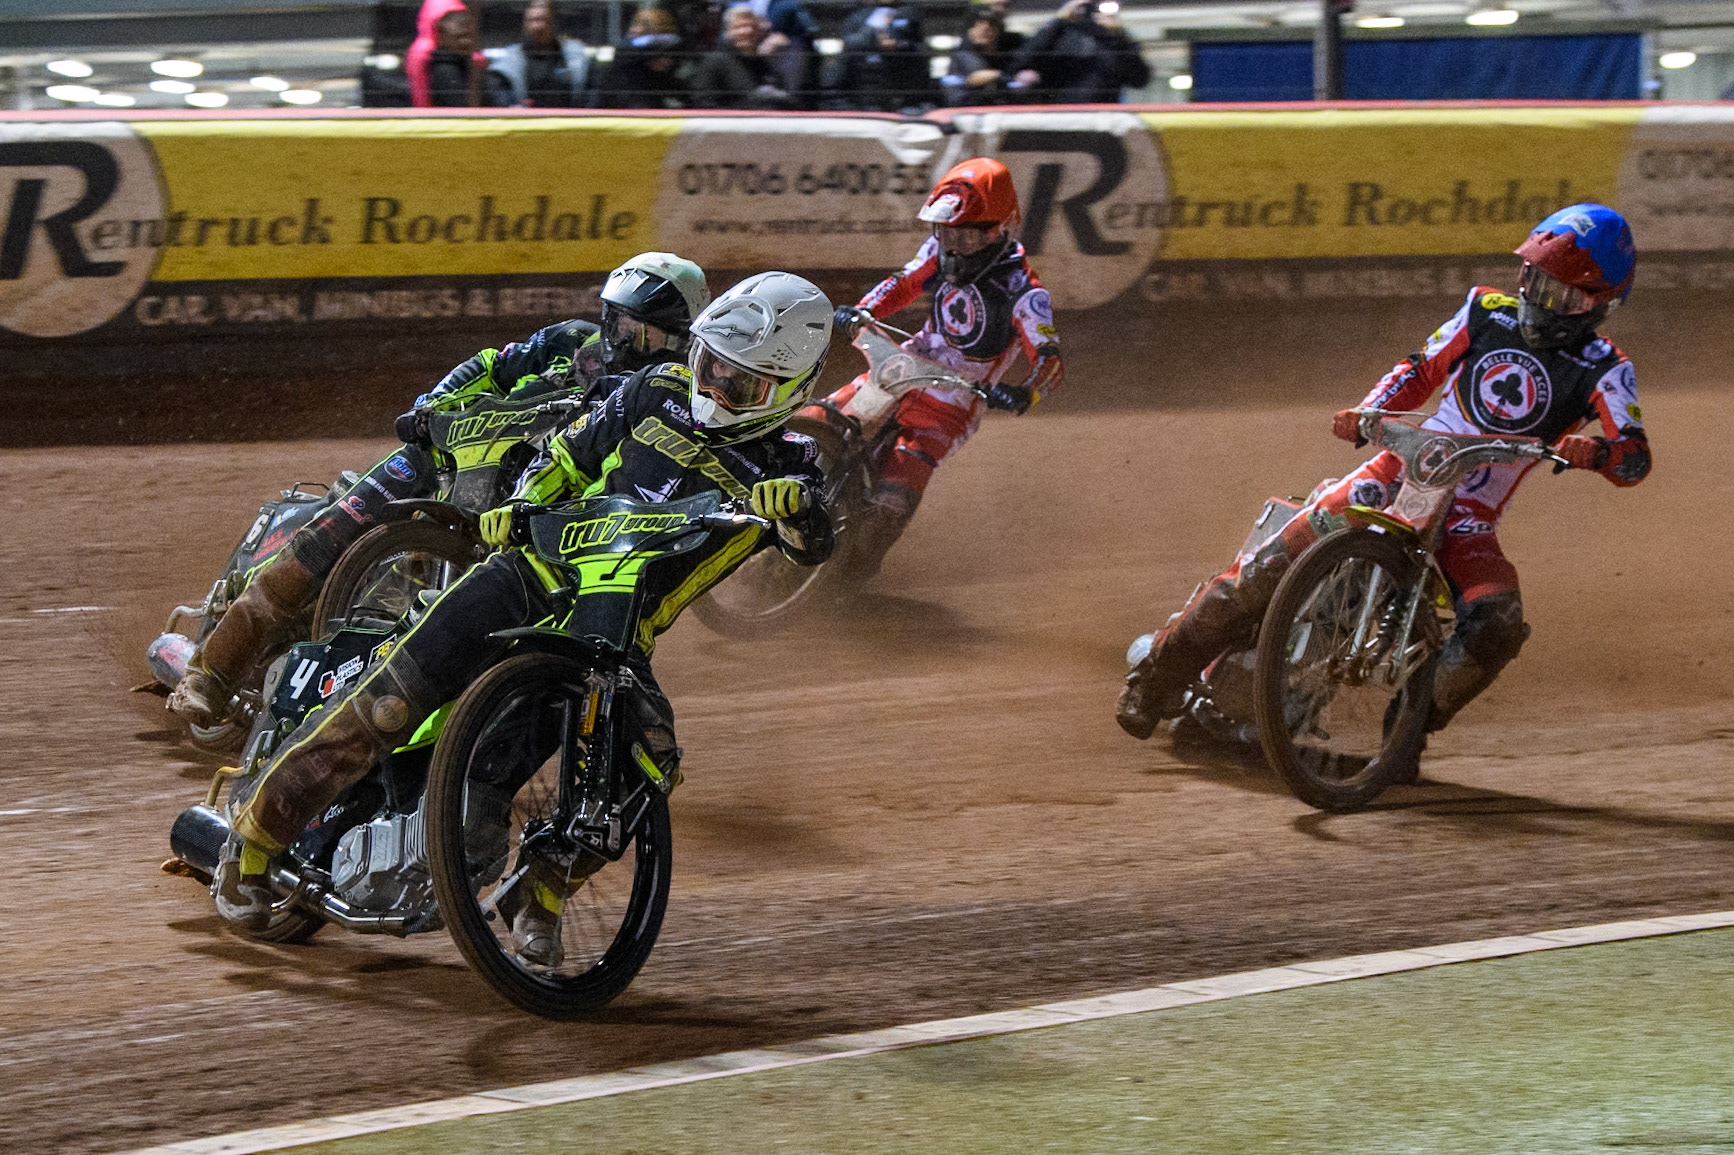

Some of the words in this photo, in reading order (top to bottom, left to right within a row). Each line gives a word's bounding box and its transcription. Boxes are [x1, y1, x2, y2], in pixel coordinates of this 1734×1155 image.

[677, 162, 788, 195] 01706
[359, 195, 640, 246] Rochdale
[1344, 179, 1600, 228] Rochdal
[1482, 354, 1513, 370] BELLE
[1518, 355, 1537, 373] VUE
[1535, 375, 1547, 402] ACES
[662, 398, 692, 421] ROW
[631, 416, 753, 499] tru7grou
[558, 511, 687, 555] tru7group
[290, 658, 319, 699] 4
